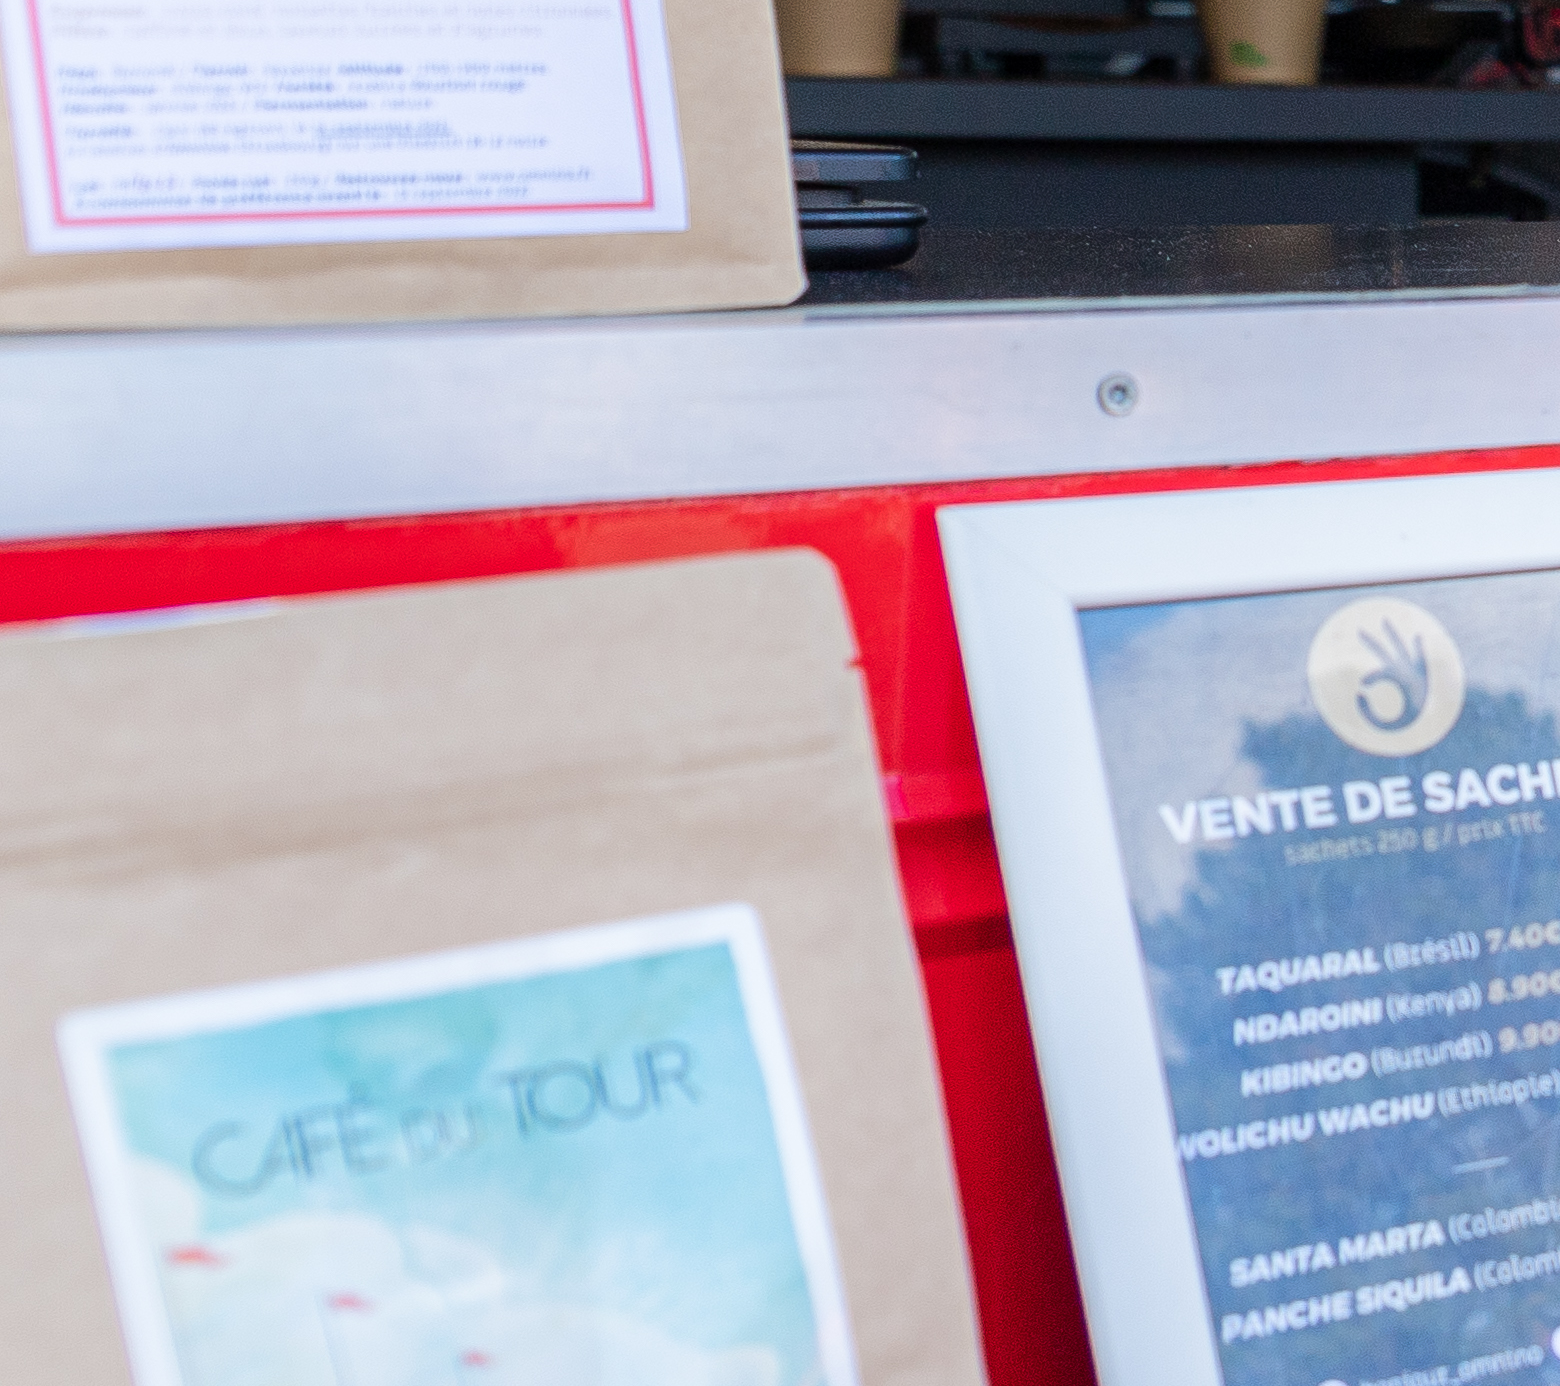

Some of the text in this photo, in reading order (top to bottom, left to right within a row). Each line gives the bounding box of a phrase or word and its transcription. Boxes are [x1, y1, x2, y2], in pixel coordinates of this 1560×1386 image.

[1159, 785, 1338, 844] VENTE
[1342, 776, 1417, 824] DE
[1215, 946, 1381, 996] TAQUARAL
[1233, 997, 1383, 1037] NDAROINI
[1240, 1051, 1369, 1097] KIBINGO
[191, 1079, 392, 1199] CAFÉ
[495, 1038, 703, 1141] TOUR
[1317, 1091, 1435, 1137] WACHU
[1229, 1241, 1336, 1289] SANTA
[1338, 1219, 1446, 1264] MARTA
[1221, 1290, 1354, 1345] PANCHE
[1355, 1266, 1472, 1316] SIQUILA
